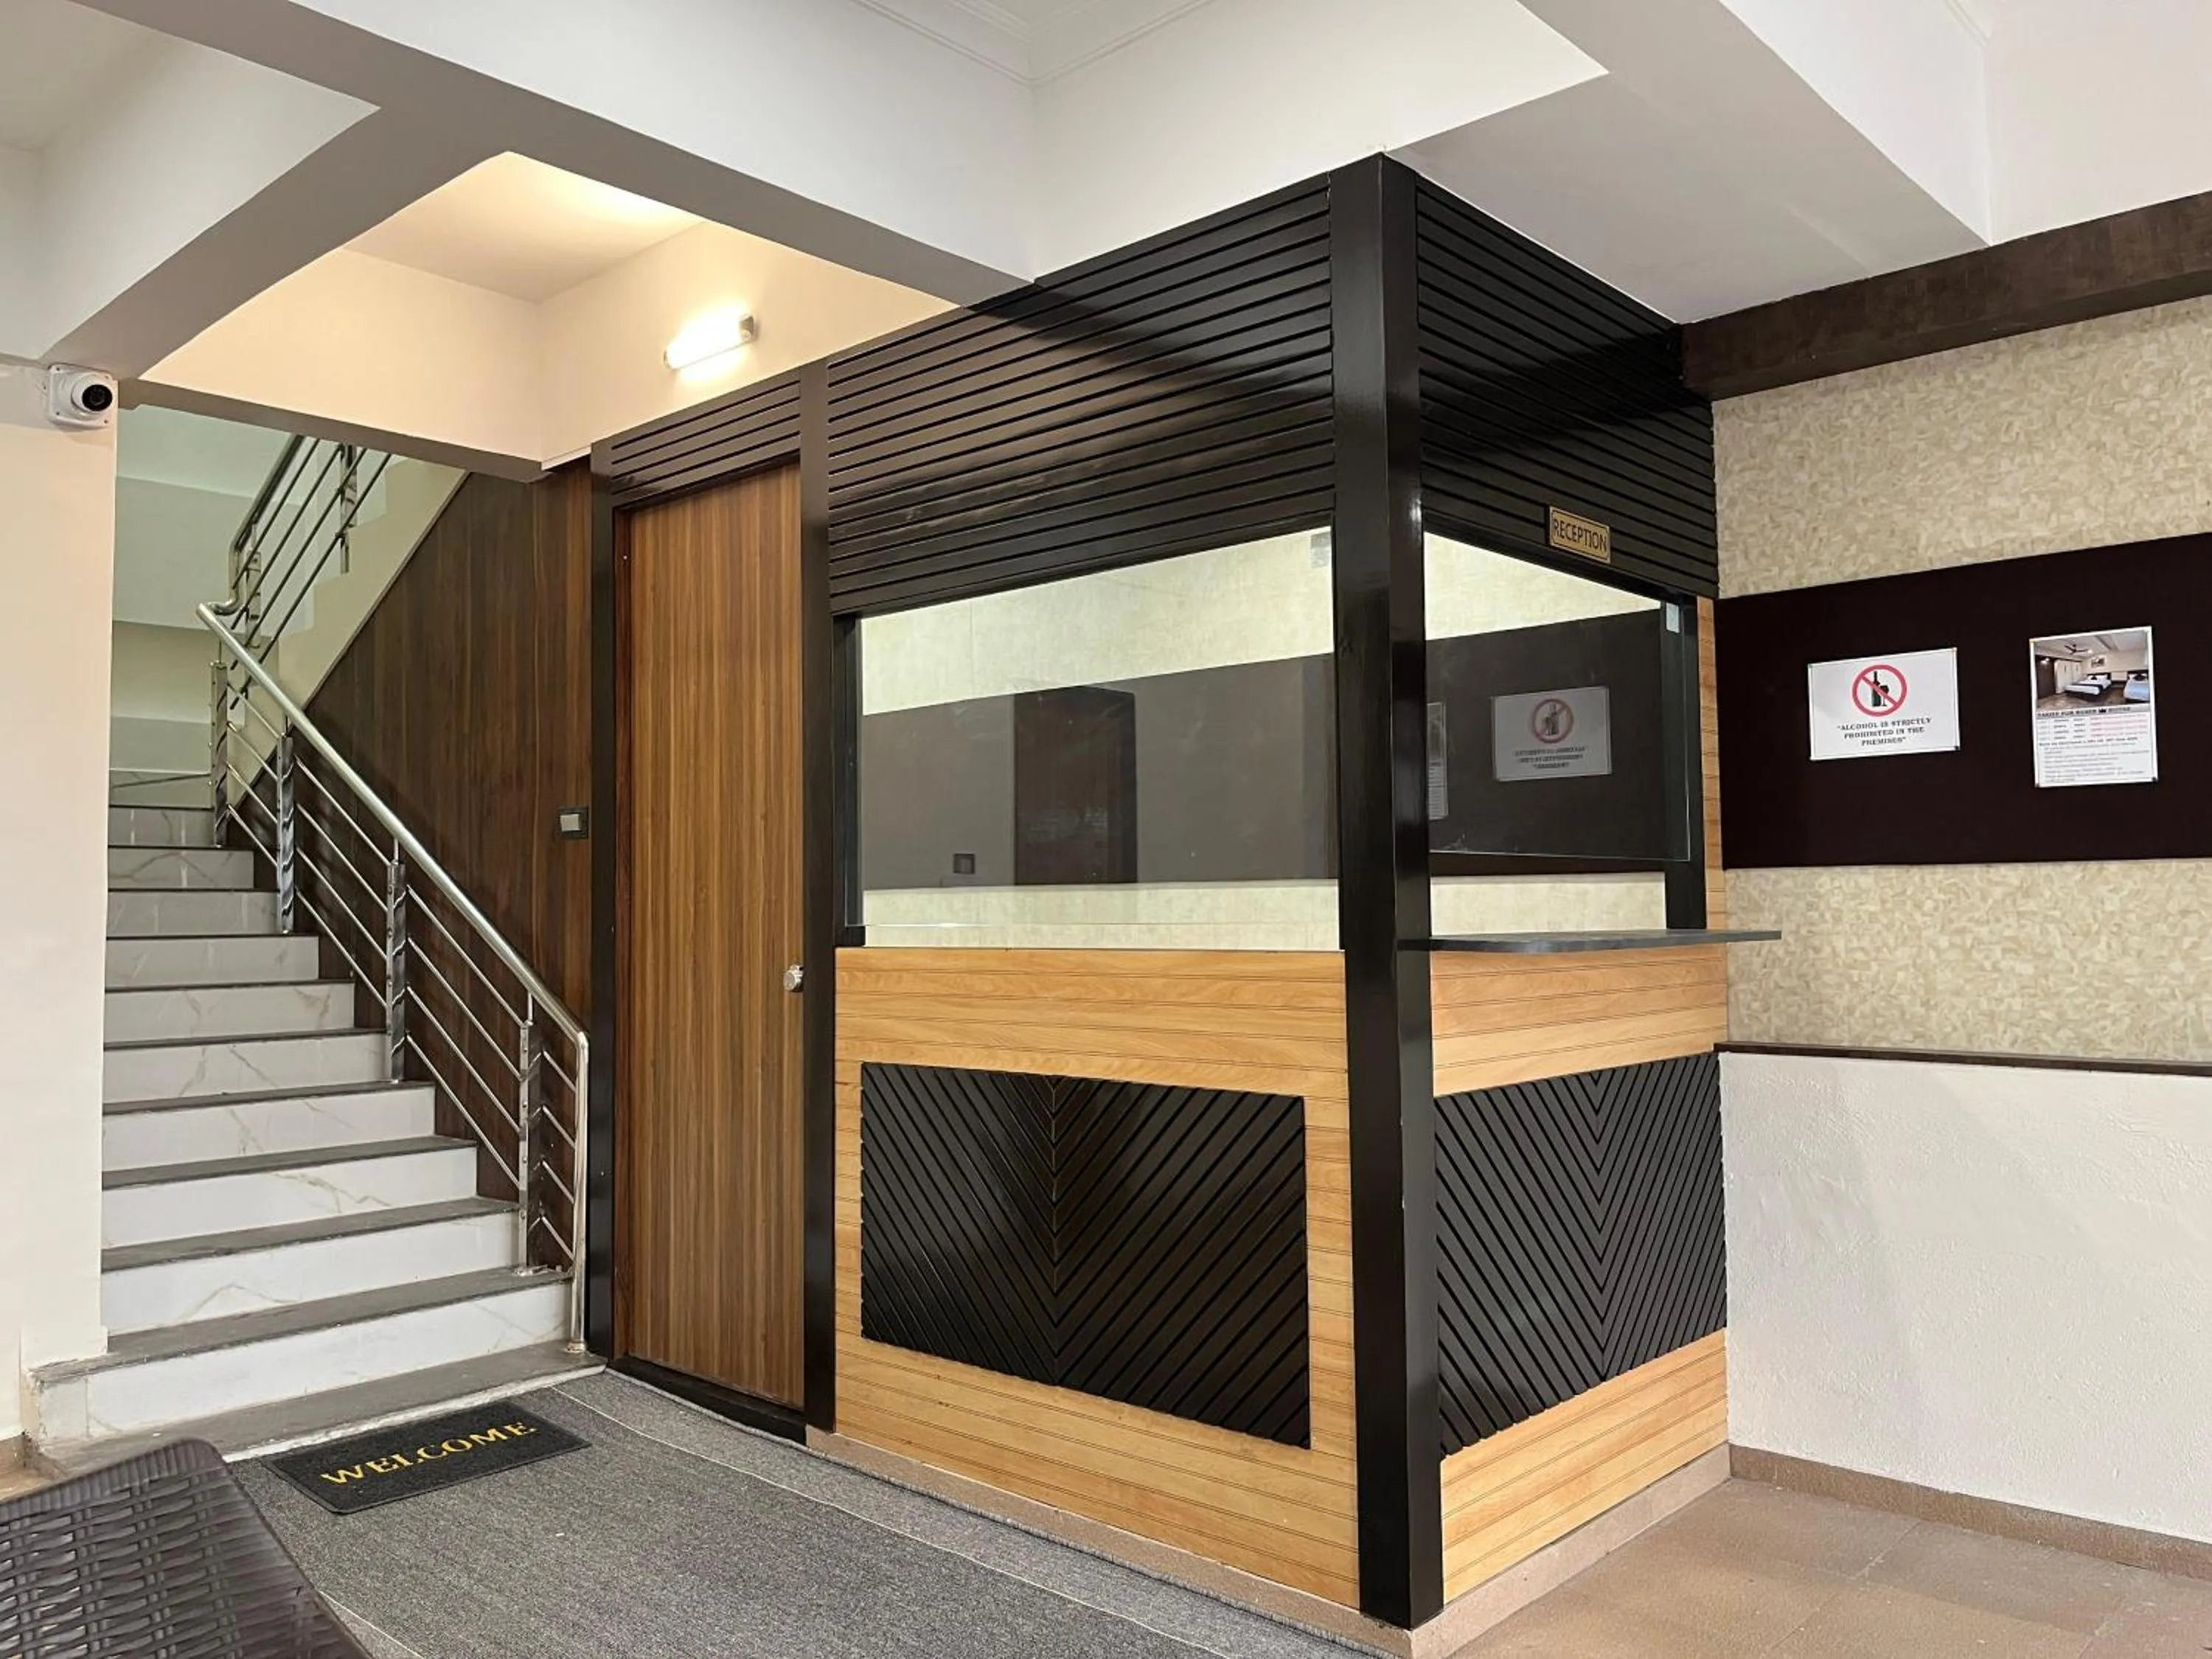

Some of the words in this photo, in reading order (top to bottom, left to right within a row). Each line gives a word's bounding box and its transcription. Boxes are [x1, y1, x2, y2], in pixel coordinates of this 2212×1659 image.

[1553, 518, 1607, 552] RECEPTION
[1891, 717, 1932, 727] STRICTLY
[1844, 729, 1893, 740] PROHIBITED
[321, 1422, 539, 1486] WELCOME
